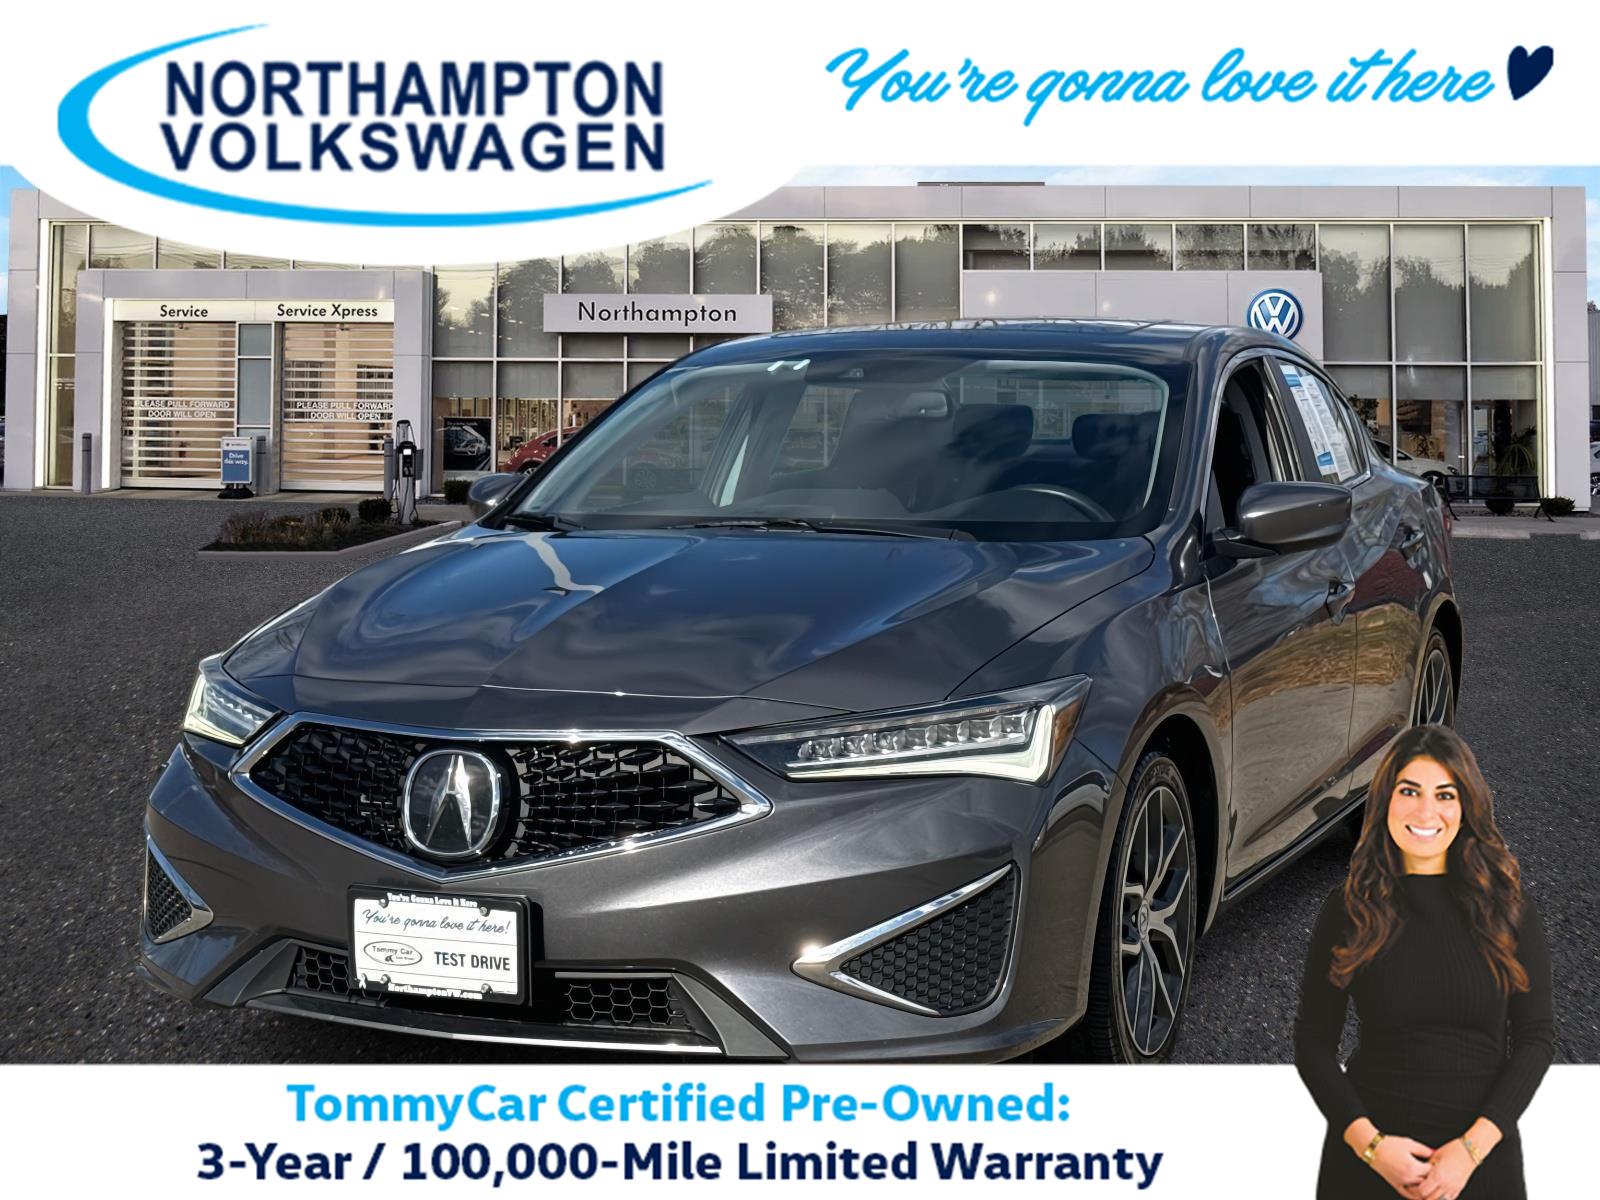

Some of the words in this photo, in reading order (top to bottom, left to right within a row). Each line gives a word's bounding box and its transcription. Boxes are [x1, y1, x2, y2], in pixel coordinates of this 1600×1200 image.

[159, 304, 209, 318] Service
[276, 303, 327, 317] Service
[330, 303, 379, 320] Xpress
[578, 301, 737, 326] Northampton
[296, 401, 329, 409] PLEASE
[330, 401, 352, 409] PULL
[353, 401, 394, 410] FORWARD
[310, 412, 335, 420] DOOR
[335, 412, 357, 420] WILL
[357, 412, 381, 420] OPEN
[362, 908, 400, 924] You're
[404, 918, 436, 931] gonna
[440, 916, 464, 929] love
[466, 918, 478, 930] it
[479, 919, 511, 934] here!
[372, 945, 398, 955] Tommy
[400, 947, 413, 955] Car
[434, 951, 466, 967] TEST
[471, 954, 511, 971] DRIVE
[387, 982, 483, 1000] NorthamptonVW.com
